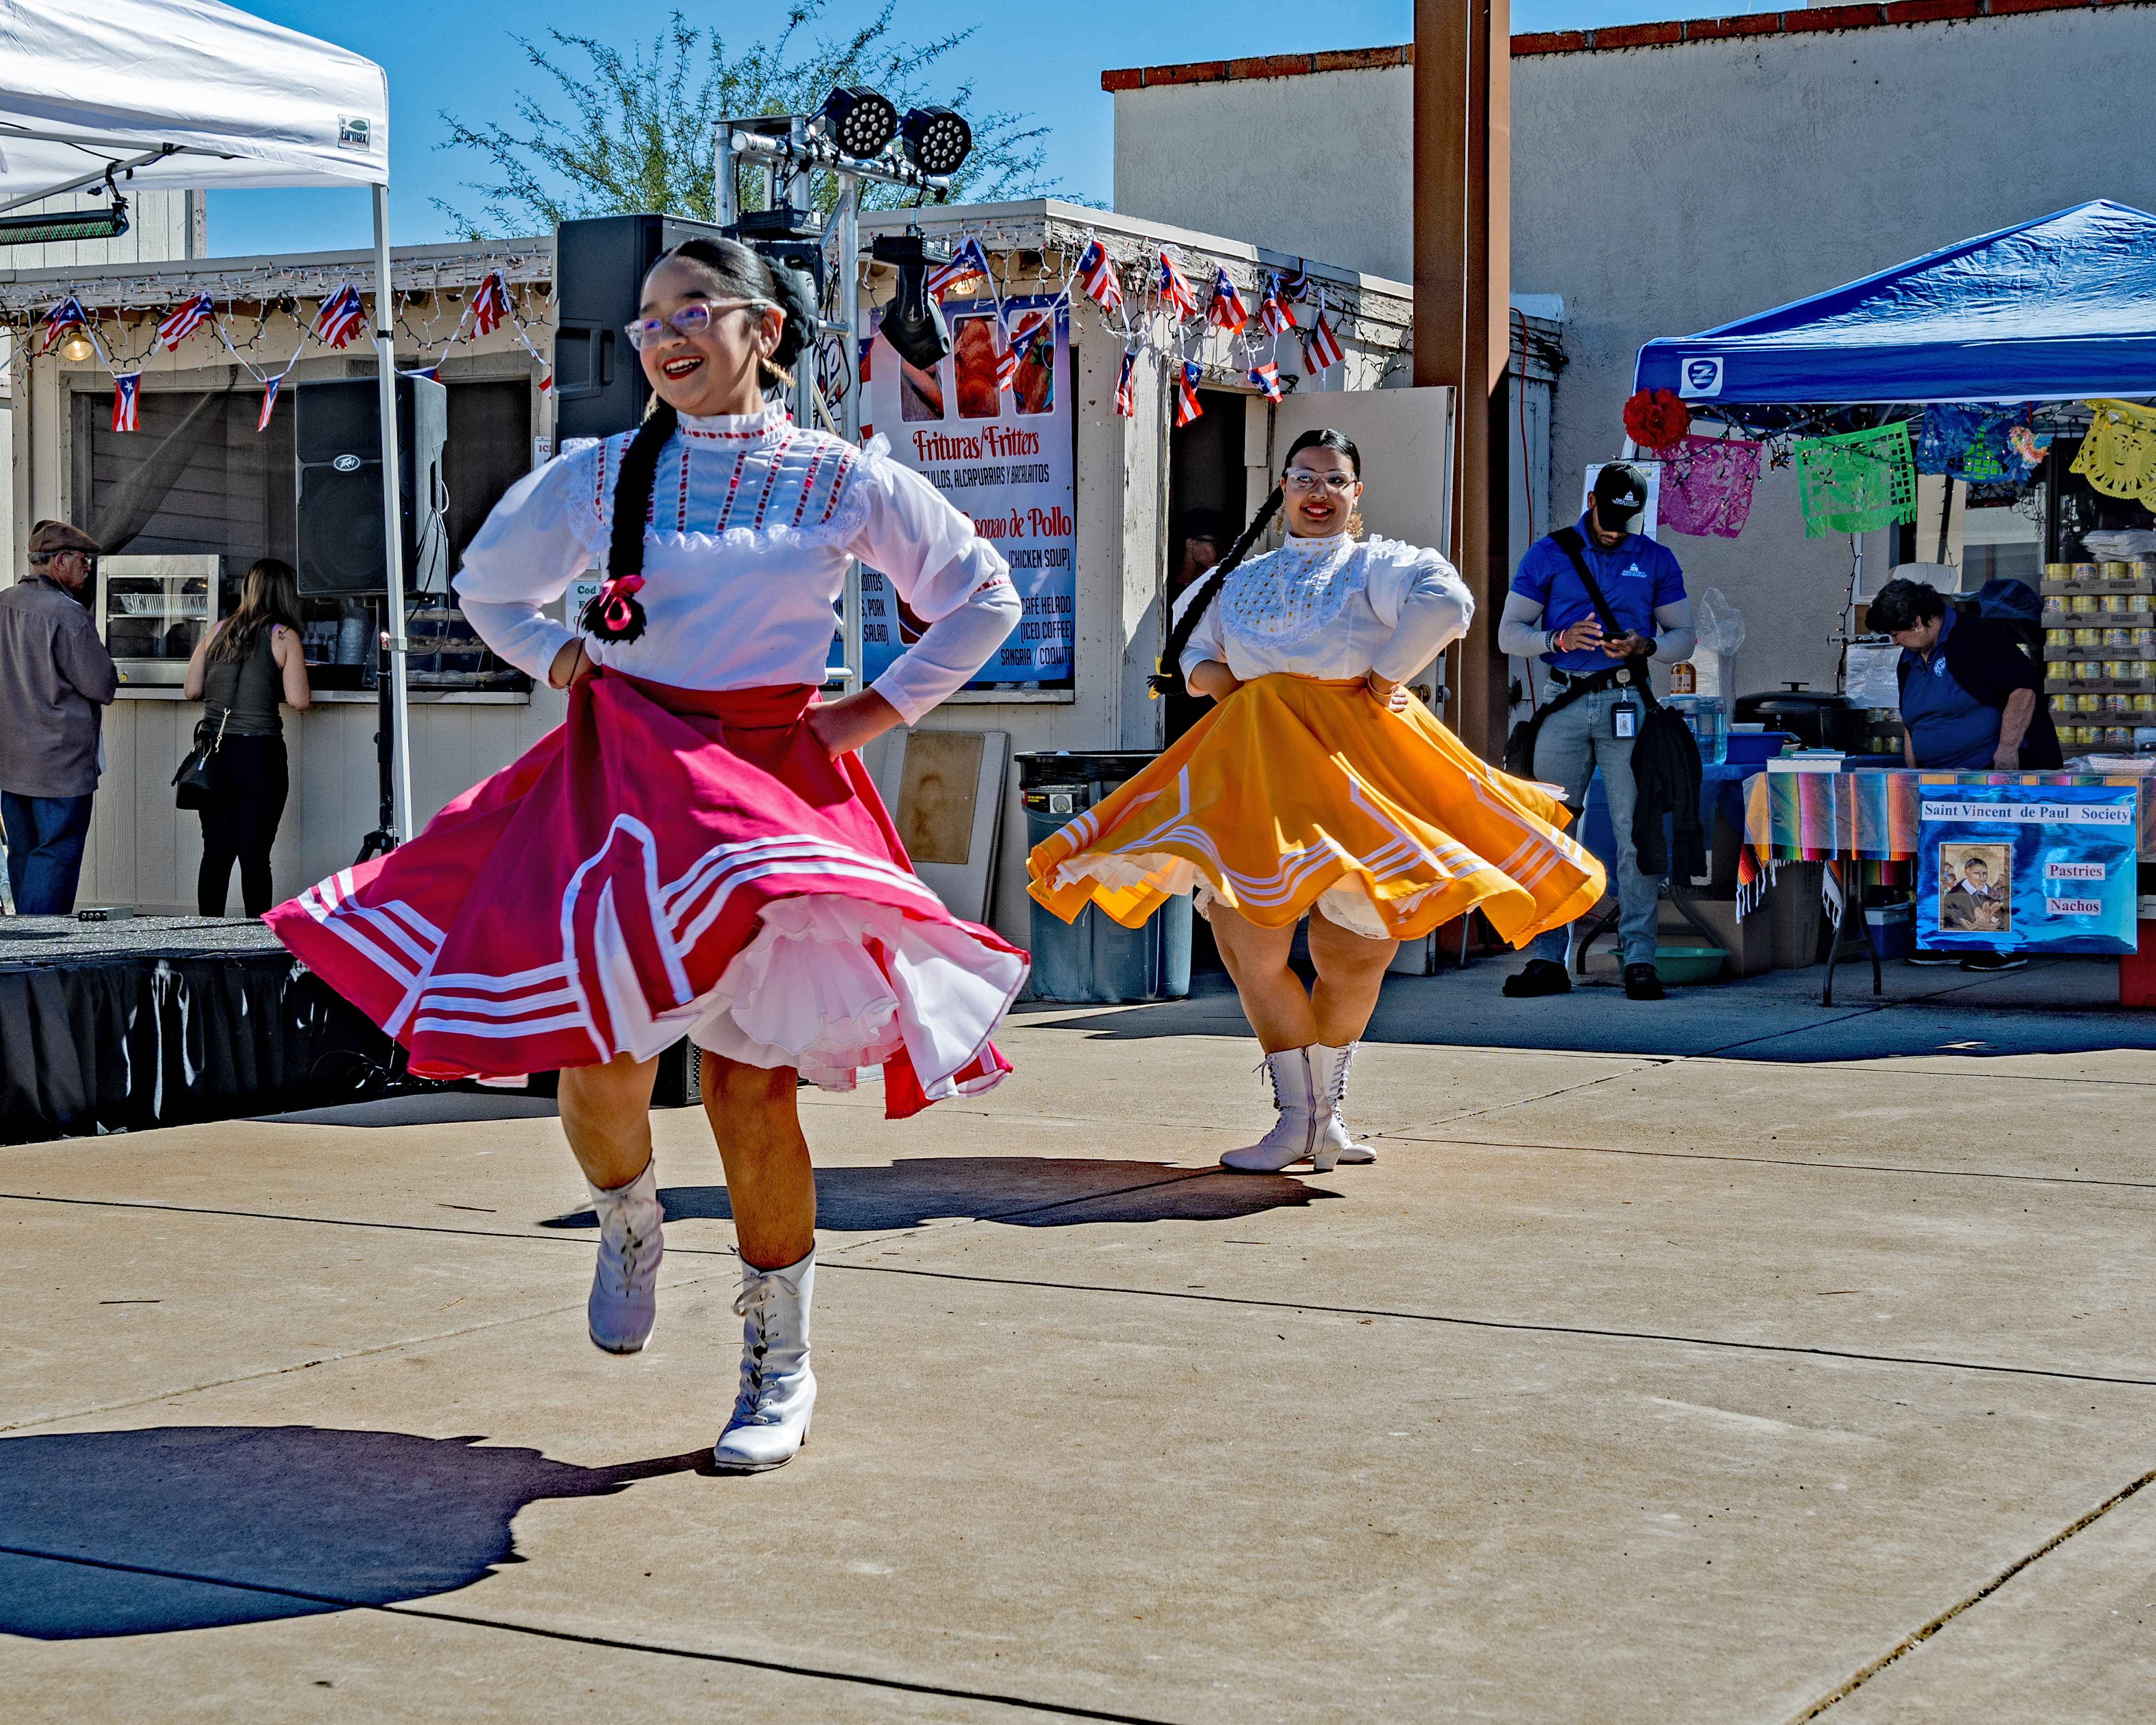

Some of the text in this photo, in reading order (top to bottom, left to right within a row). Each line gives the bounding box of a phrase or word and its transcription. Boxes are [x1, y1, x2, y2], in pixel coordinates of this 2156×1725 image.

[341, 126, 367, 144] Eurmax
[913, 426, 1039, 461] Frituras/Fritters
[954, 466, 1005, 488] ALCAPURRIAS
[1006, 466, 1011, 484] Y
[1011, 464, 1050, 484] BACALAITOS
[962, 506, 1072, 540] sopao de Pollo
[1045, 548, 1070, 571] SOUP)
[578, 586, 596, 594] Cod
[868, 599, 886, 617] PORK
[1021, 593, 1071, 615] CAFÉ HELADO
[863, 624, 889, 646] SALAD)
[1021, 620, 1072, 644] (ICED COFFEE)
[1001, 648, 1032, 666] SANGRIA
[1040, 646, 1073, 665] COQUITO
[1925, 803, 2130, 823] Saint Vincent de Paul Society
[2050, 865, 2102, 876] Pastries
[2051, 900, 2099, 912] Nachos
